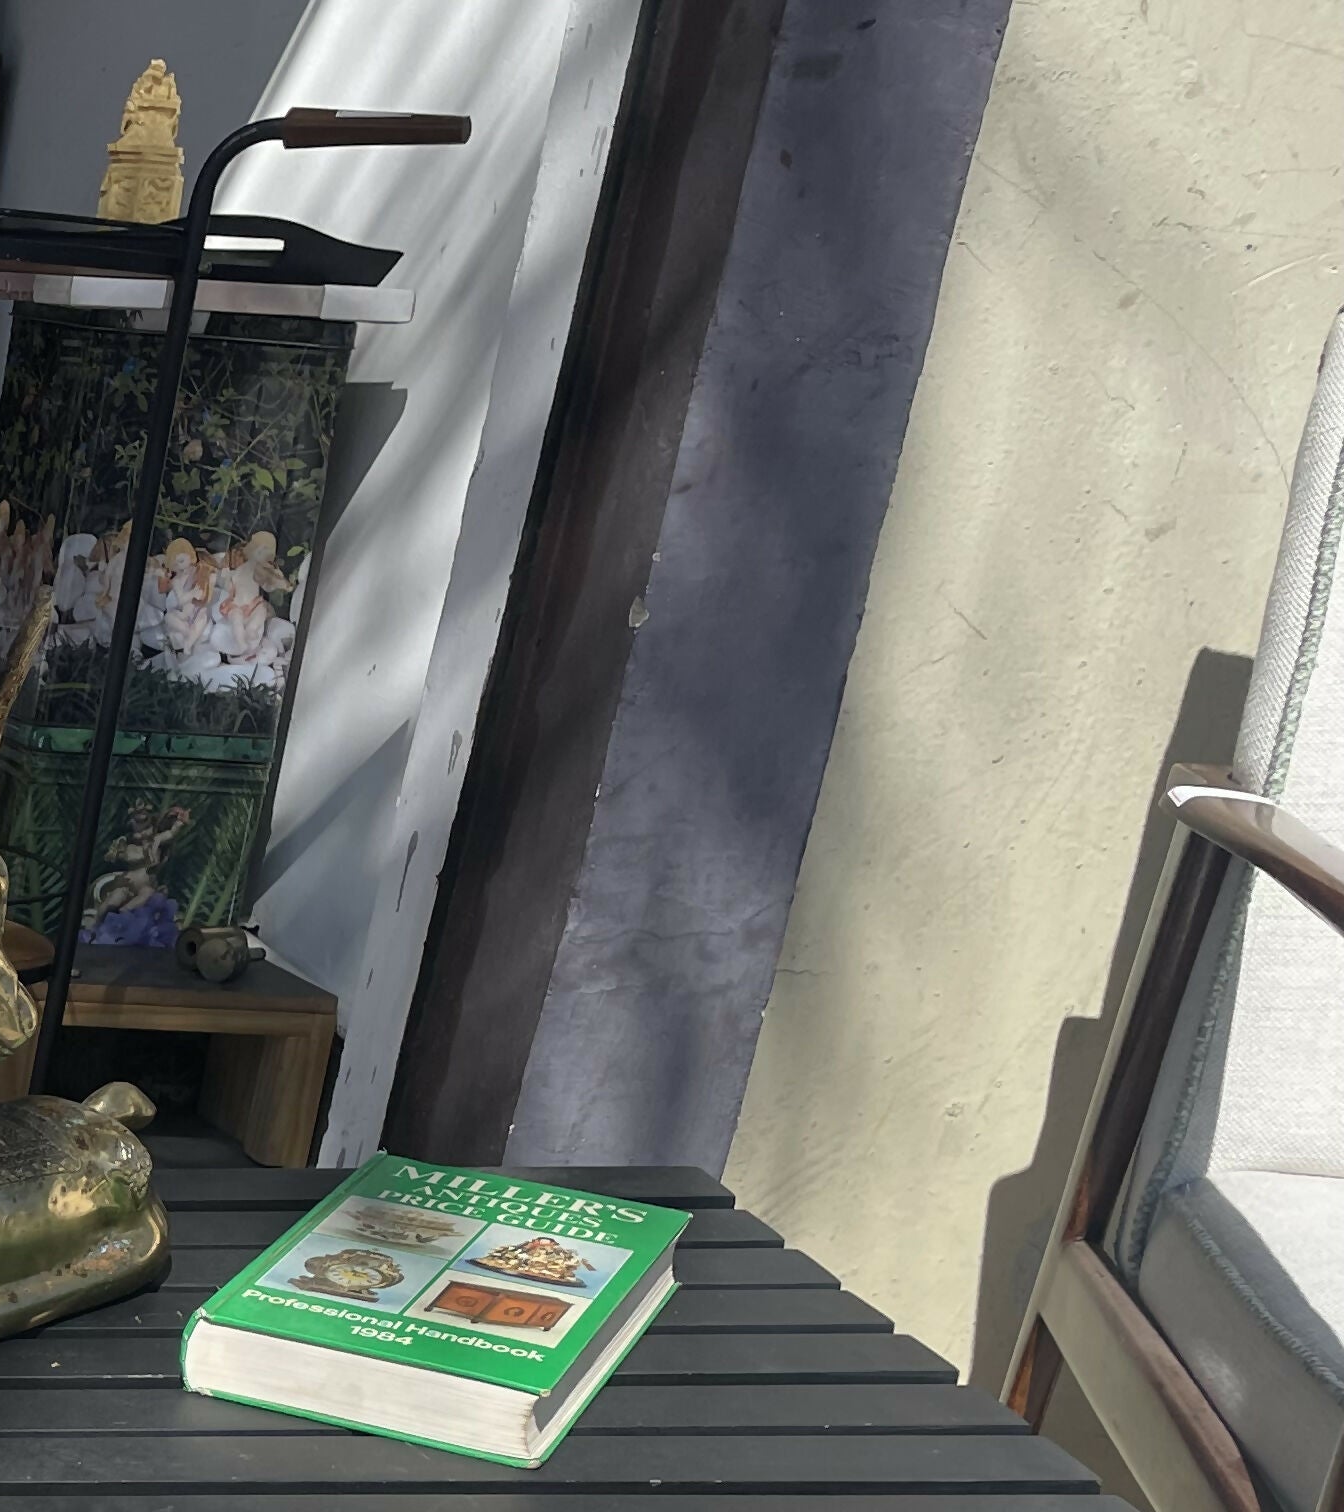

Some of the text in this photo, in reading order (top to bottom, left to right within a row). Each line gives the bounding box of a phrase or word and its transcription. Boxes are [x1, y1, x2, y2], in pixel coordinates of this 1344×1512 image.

[376, 1190, 619, 1244] PRICE GUIDE
[392, 1165, 648, 1223] MILLER'S
[413, 1185, 604, 1228] ANTIQUES
[241, 1288, 546, 1362] Professional Handbook
[349, 1325, 415, 1347] 1984
